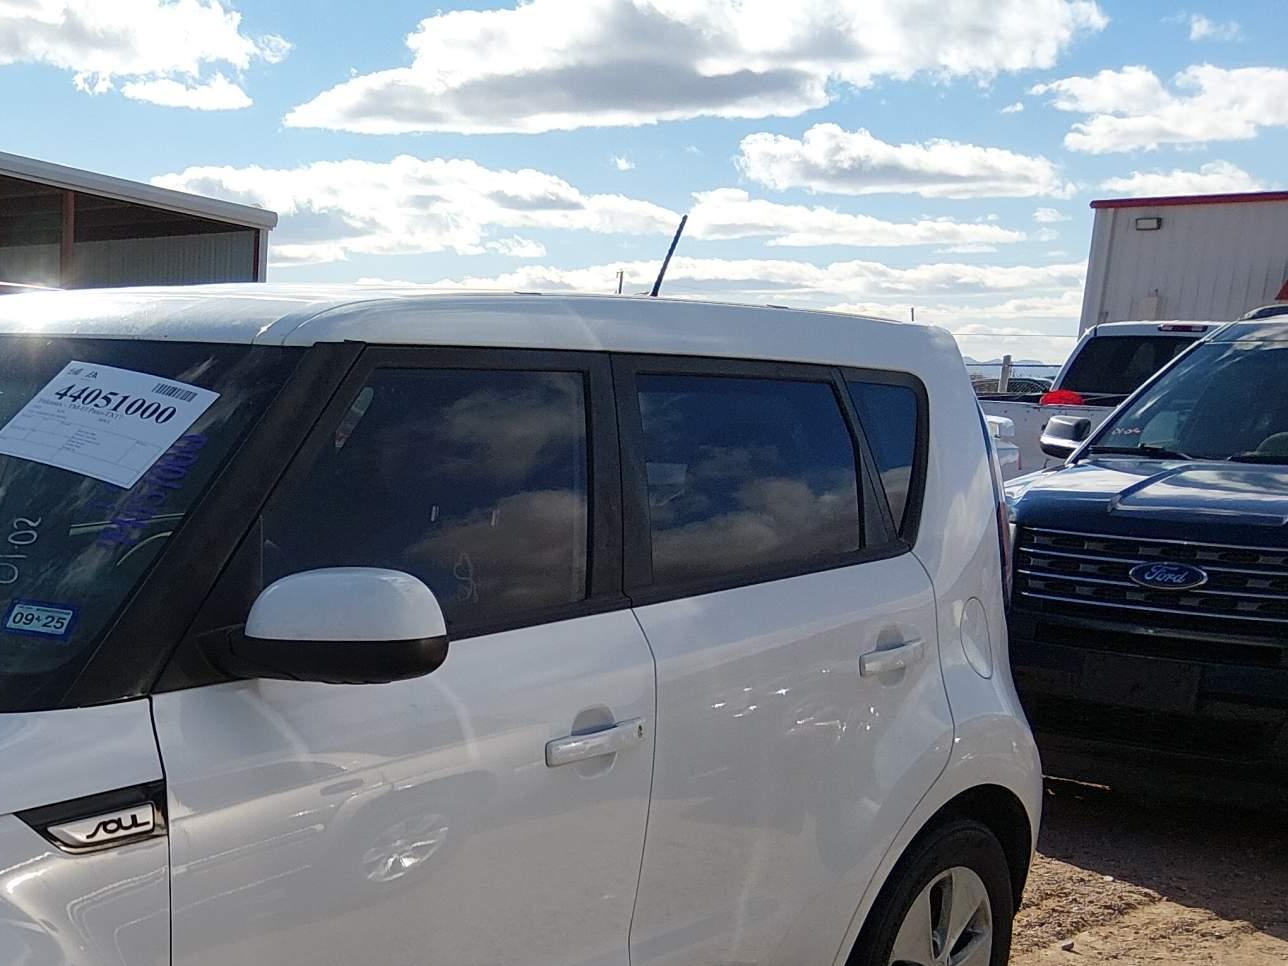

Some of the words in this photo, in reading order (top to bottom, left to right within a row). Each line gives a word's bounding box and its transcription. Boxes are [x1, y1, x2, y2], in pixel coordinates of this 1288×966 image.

[54, 384, 177, 425] 44051000
[1144, 564, 1189, 584] Ford
[12, 611, 35, 626] 09
[41, 615, 67, 630] 25
[85, 814, 151, 840] SOUL
